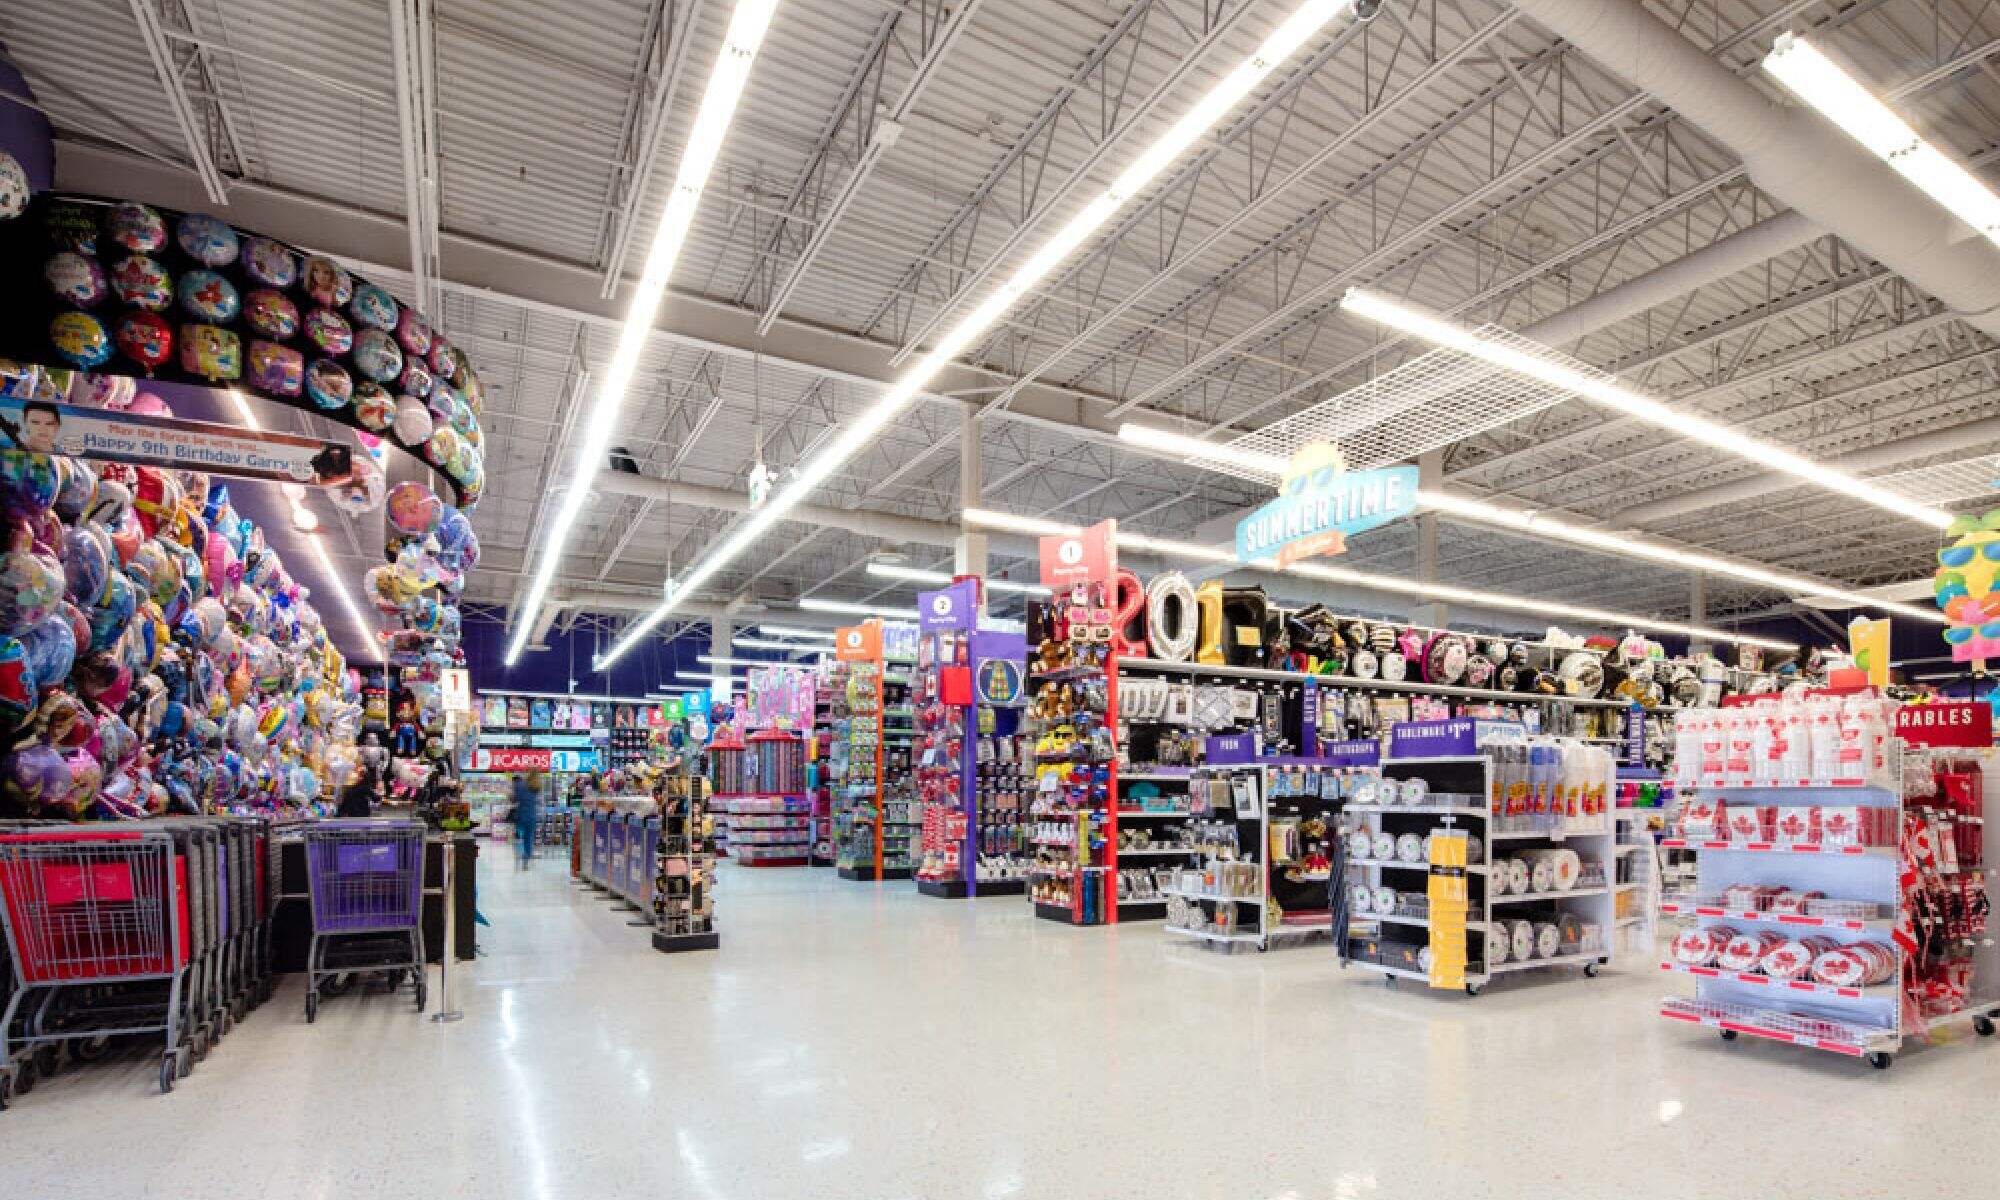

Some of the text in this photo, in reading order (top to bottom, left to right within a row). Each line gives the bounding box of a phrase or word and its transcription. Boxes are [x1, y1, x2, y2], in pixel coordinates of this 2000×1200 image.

[84, 432, 136, 451] Happy
[142, 440, 169, 456] 9th
[176, 444, 241, 464] Birthday
[1247, 475, 1402, 551] SUMMERTIME
[1891, 707, 1973, 727] RABLES
